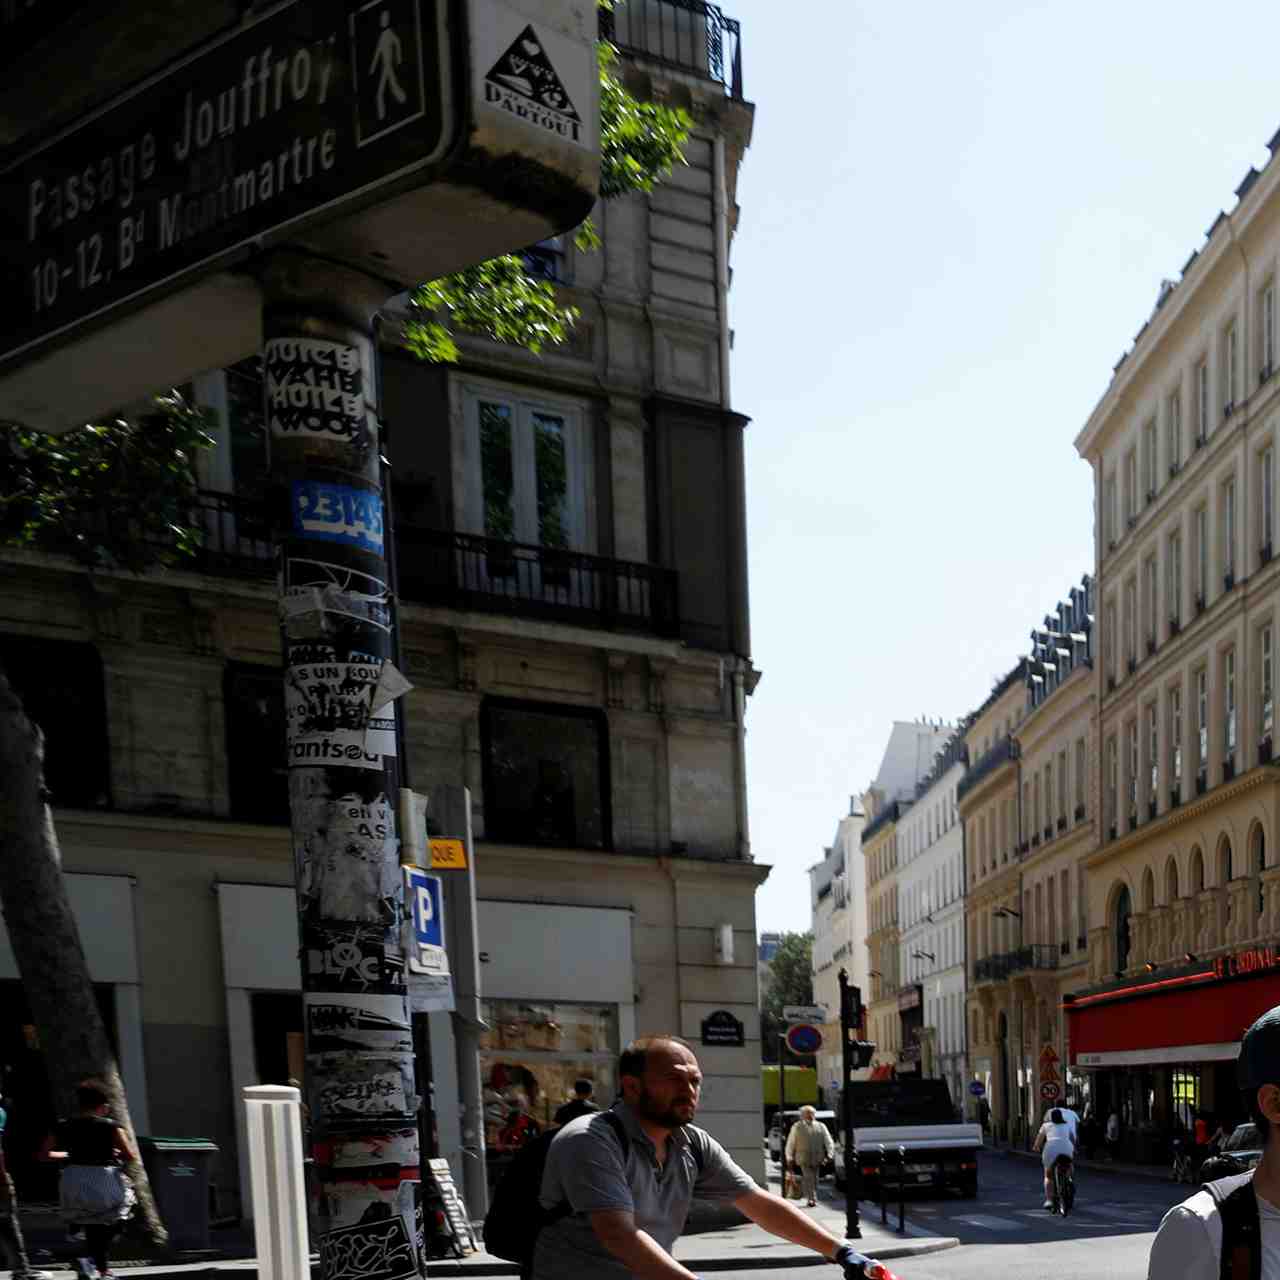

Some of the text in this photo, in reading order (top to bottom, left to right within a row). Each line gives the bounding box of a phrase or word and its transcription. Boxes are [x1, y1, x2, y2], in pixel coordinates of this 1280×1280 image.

[28, 131, 156, 243] Passage
[157, 128, 336, 253] Montmartre
[416, 885, 433, 933] P
